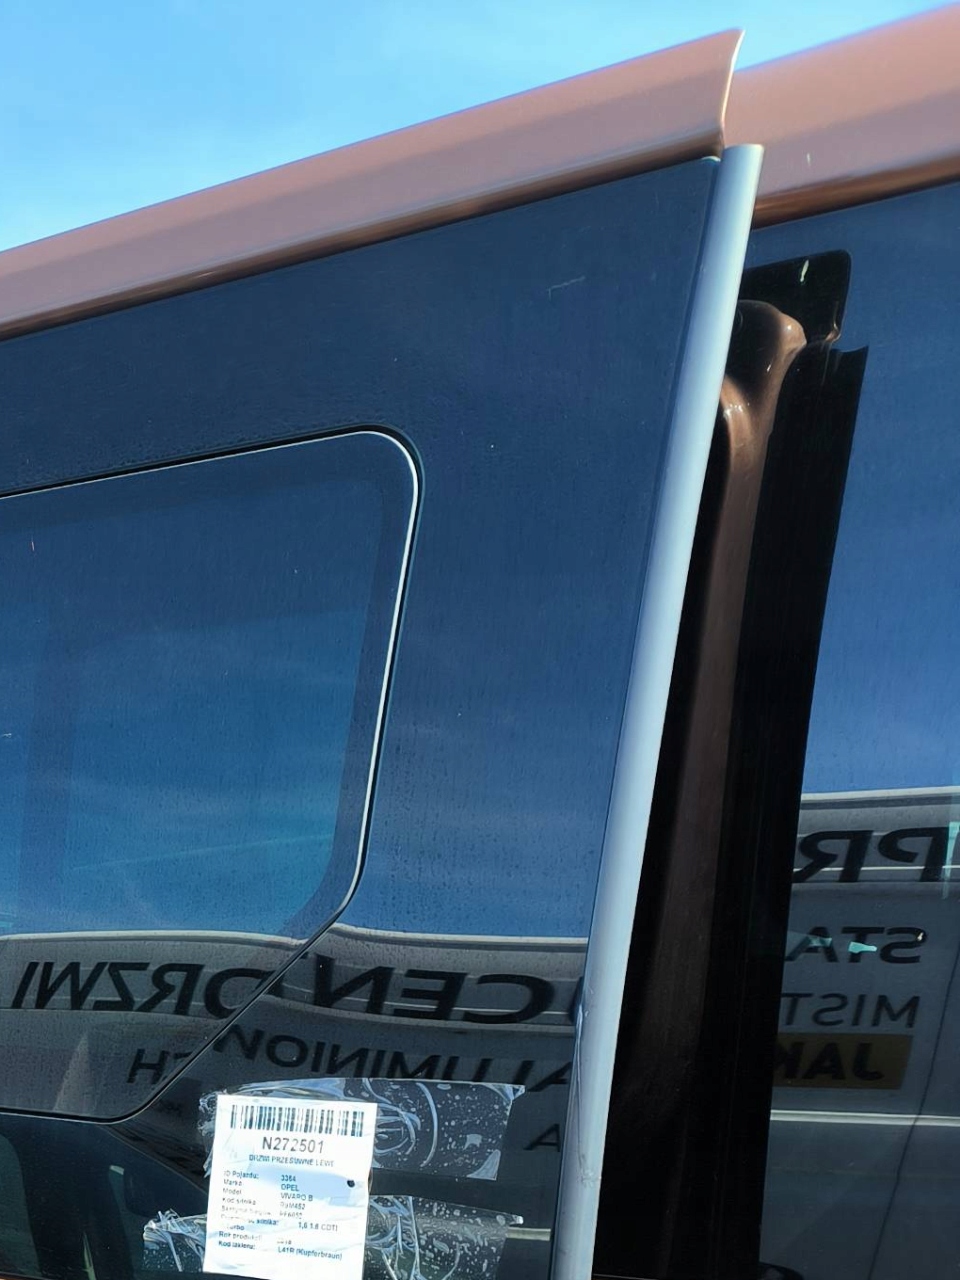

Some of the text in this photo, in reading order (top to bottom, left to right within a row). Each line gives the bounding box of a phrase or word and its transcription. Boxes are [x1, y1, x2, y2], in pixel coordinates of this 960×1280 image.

[262, 1137, 324, 1153] N272501
[249, 1154, 270, 1162] DRZWI
[281, 1183, 300, 1192] OPEL
[309, 1194, 314, 1202] B
